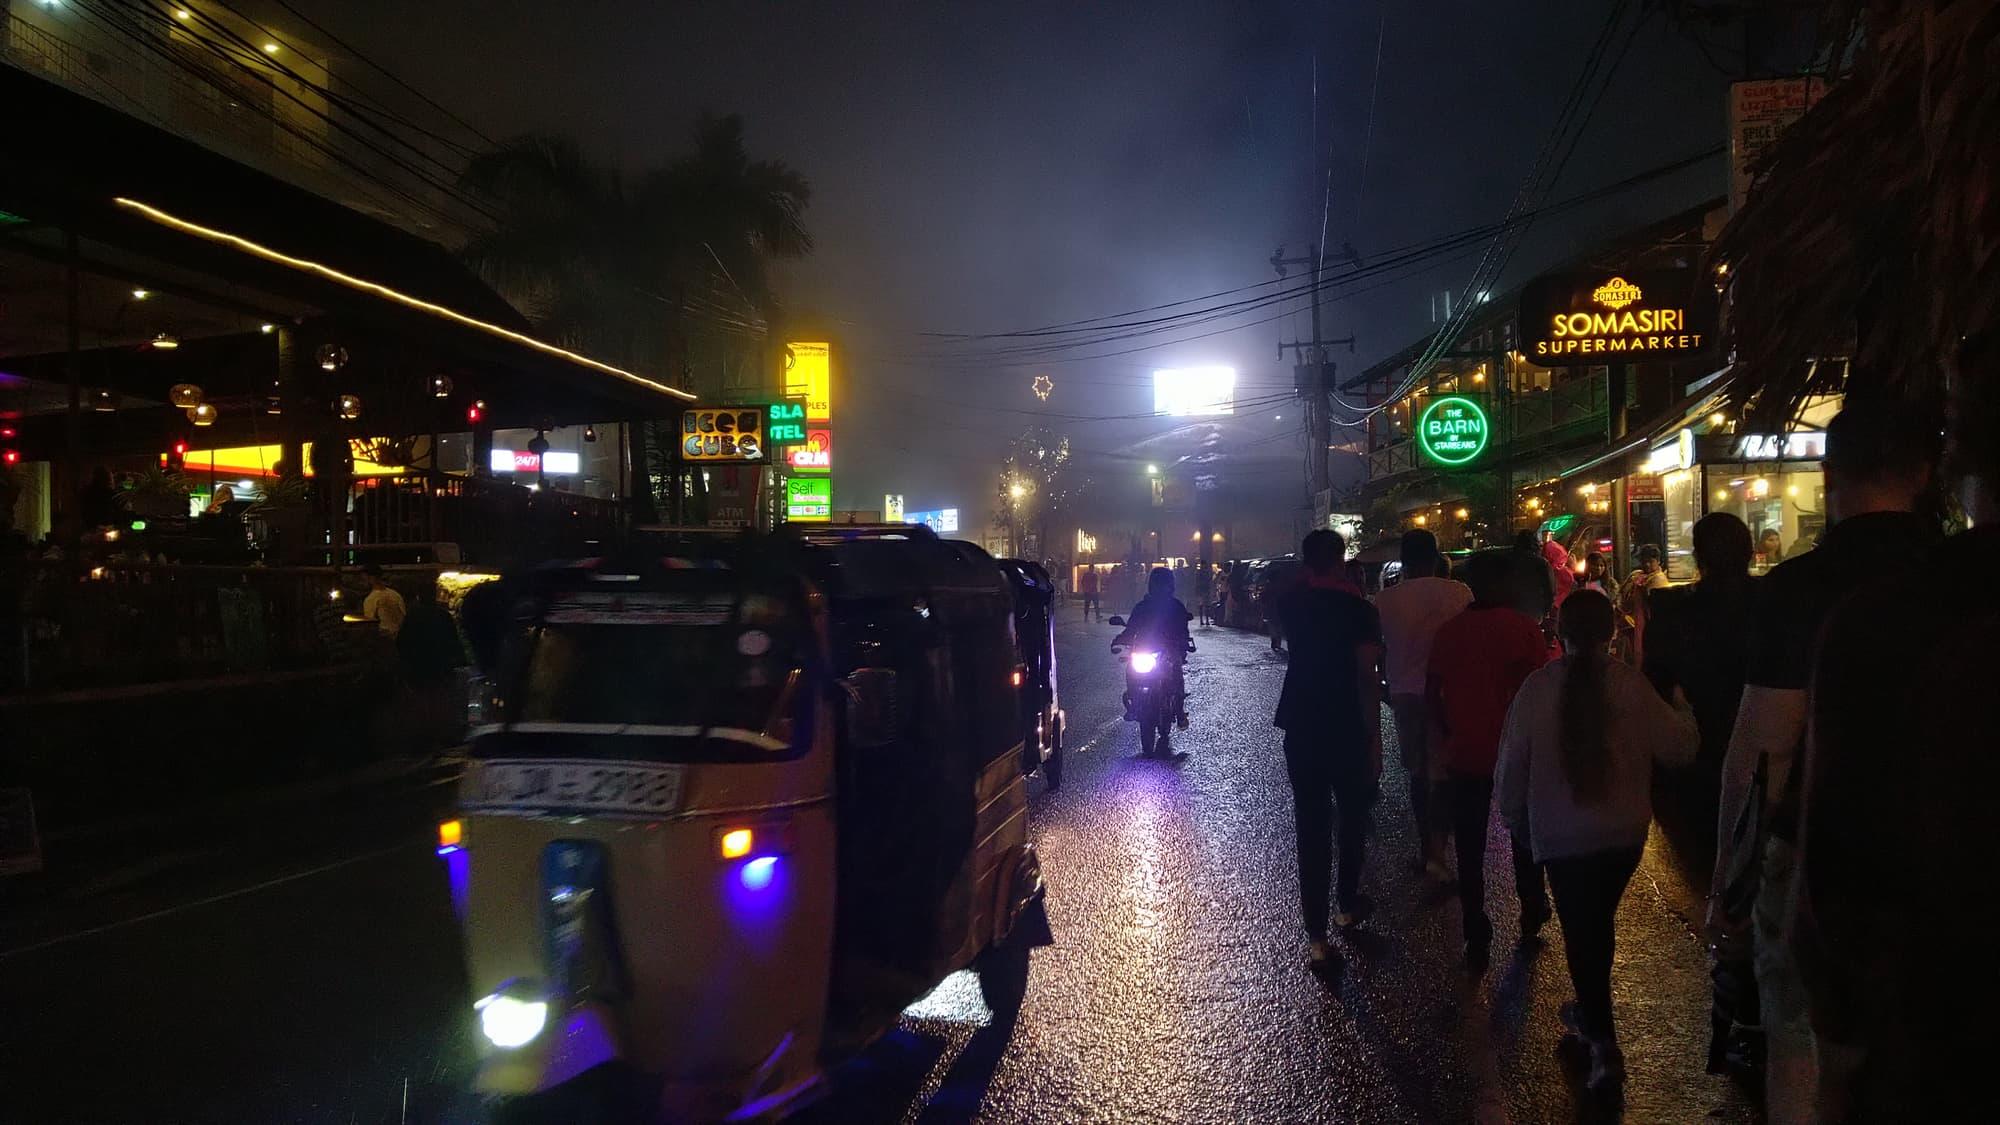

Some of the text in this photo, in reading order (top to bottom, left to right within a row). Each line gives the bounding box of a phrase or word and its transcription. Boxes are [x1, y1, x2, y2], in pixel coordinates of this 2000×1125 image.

[1593, 290, 1642, 302] SOMASIRI
[1554, 309, 1683, 337] SOMASIRI
[1538, 335, 1702, 355] SUPERMARKET
[1446, 409, 1463, 418] THE
[1429, 419, 1481, 435] BARN
[515, 455, 538, 467] 24/7
[790, 480, 815, 495] Self
